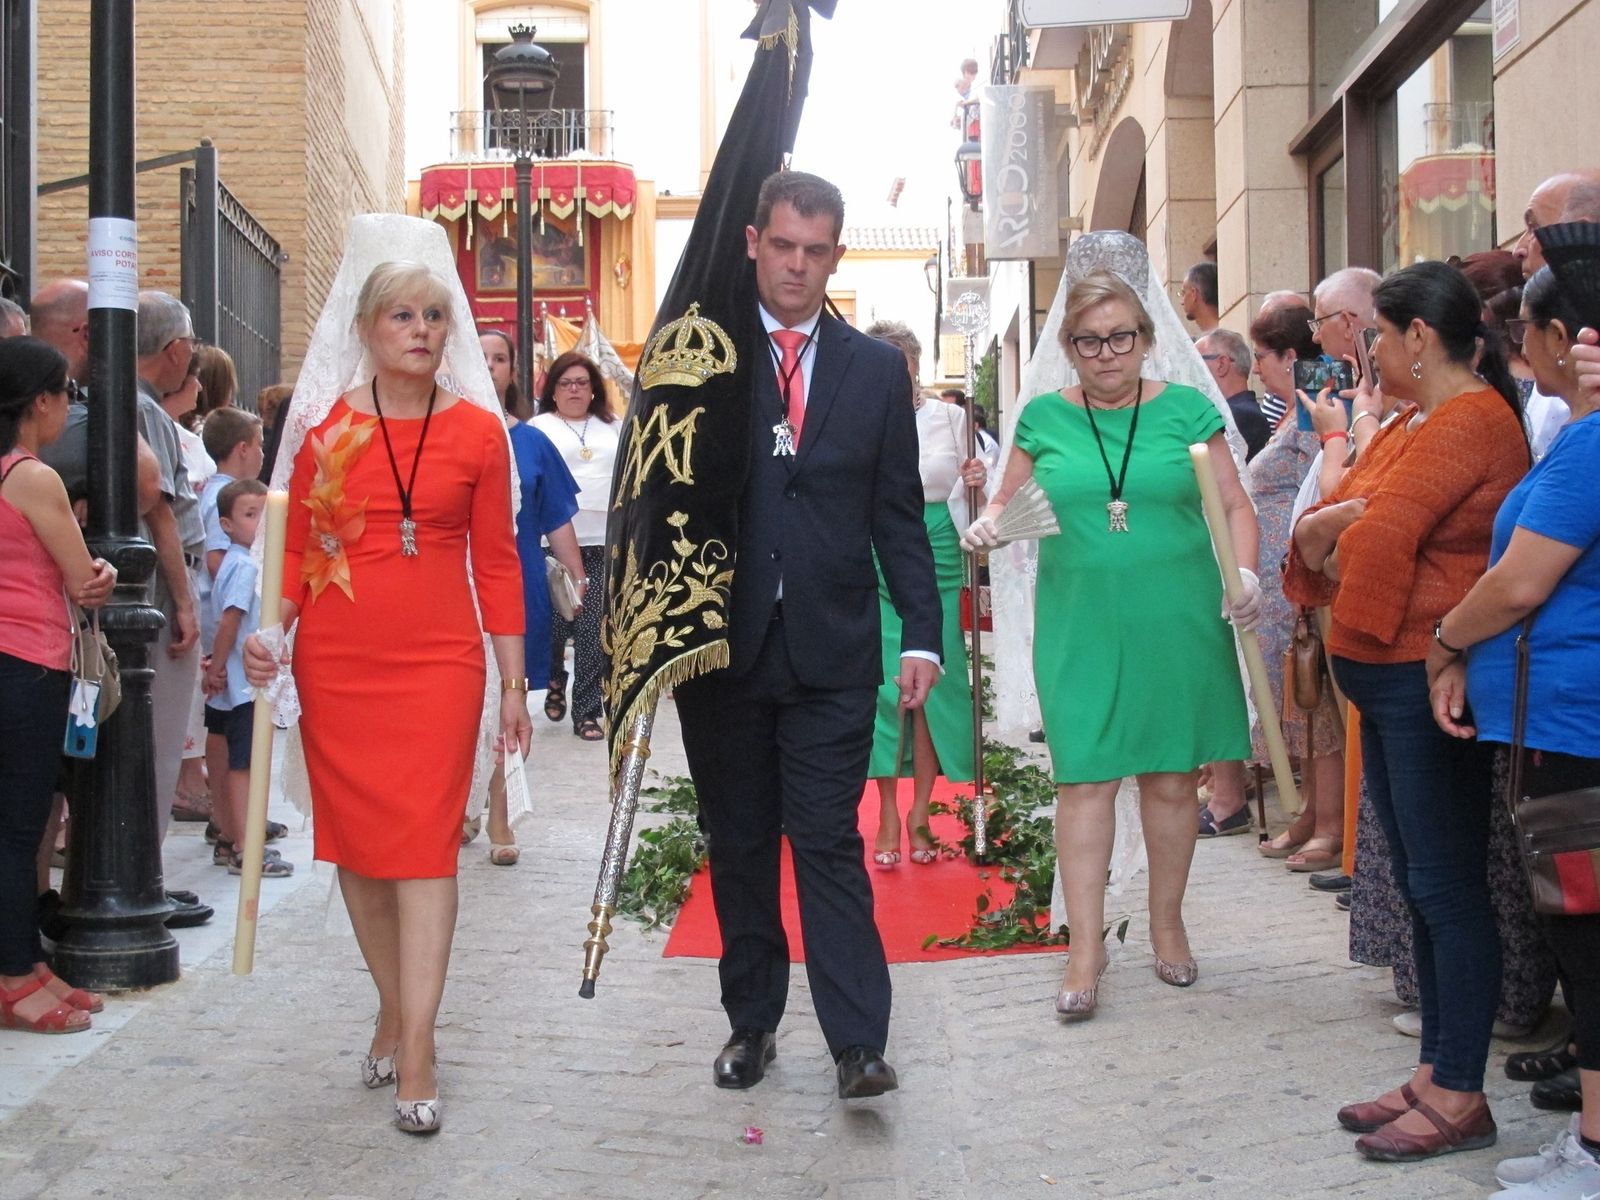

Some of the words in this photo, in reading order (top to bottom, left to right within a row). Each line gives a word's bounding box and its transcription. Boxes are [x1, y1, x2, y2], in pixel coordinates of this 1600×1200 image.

[1008, 91, 1028, 160] 2000
[997, 164, 1030, 248] ARCO
[91, 249, 113, 257] AVISO
